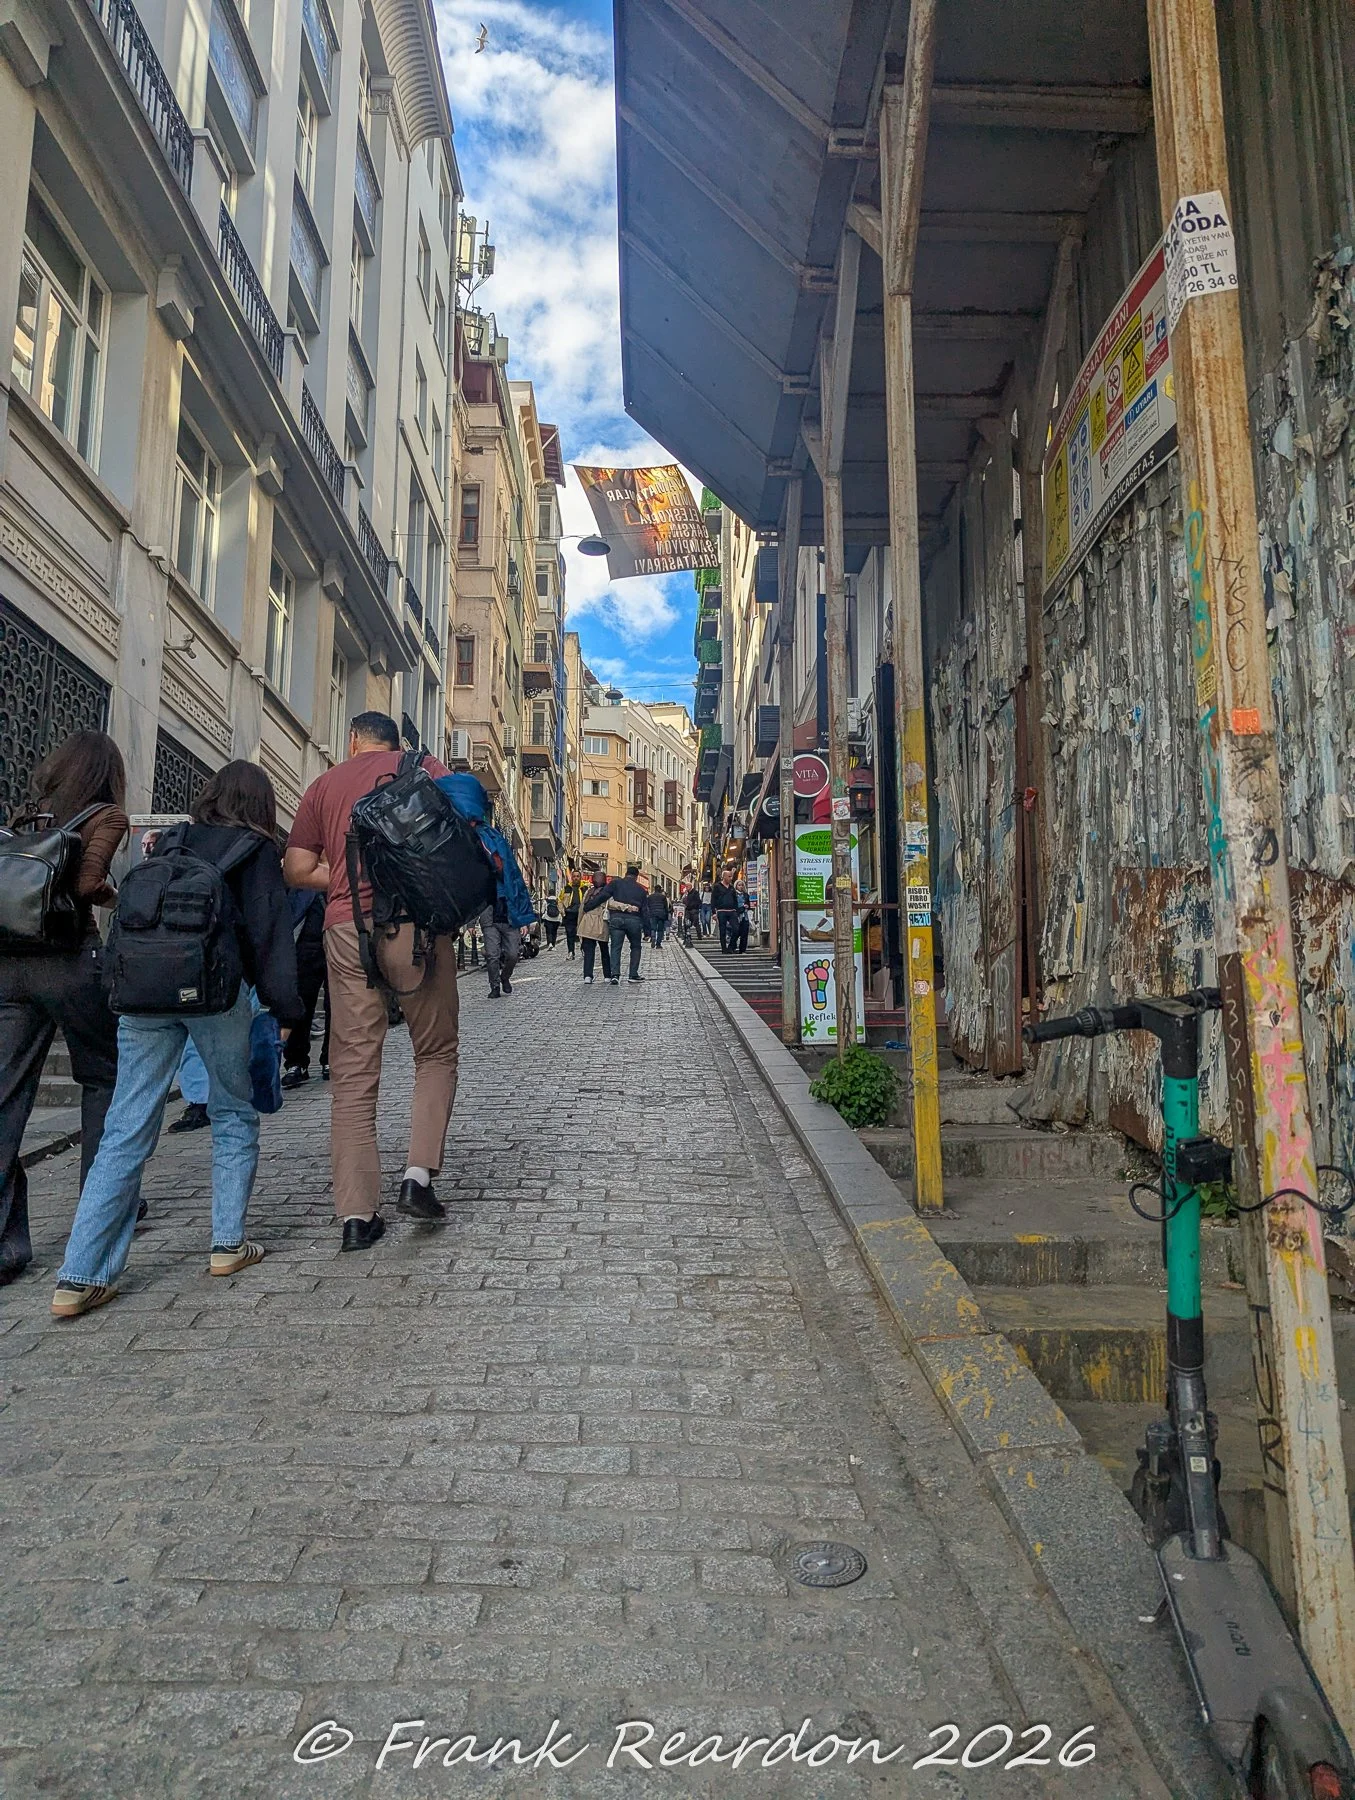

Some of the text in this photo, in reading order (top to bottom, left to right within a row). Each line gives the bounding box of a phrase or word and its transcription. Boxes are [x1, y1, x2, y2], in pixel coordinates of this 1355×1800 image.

[1181, 214, 1227, 233] ODA
[1196, 252, 1214, 262] BİZE
[1216, 249, 1228, 257] AİT
[1201, 262, 1221, 274] TL
[1208, 276, 1225, 288] 34
[1135, 389, 1154, 414] UYARI
[1117, 466, 1142, 498] TİCARET
[795, 769, 819, 779] VITA
